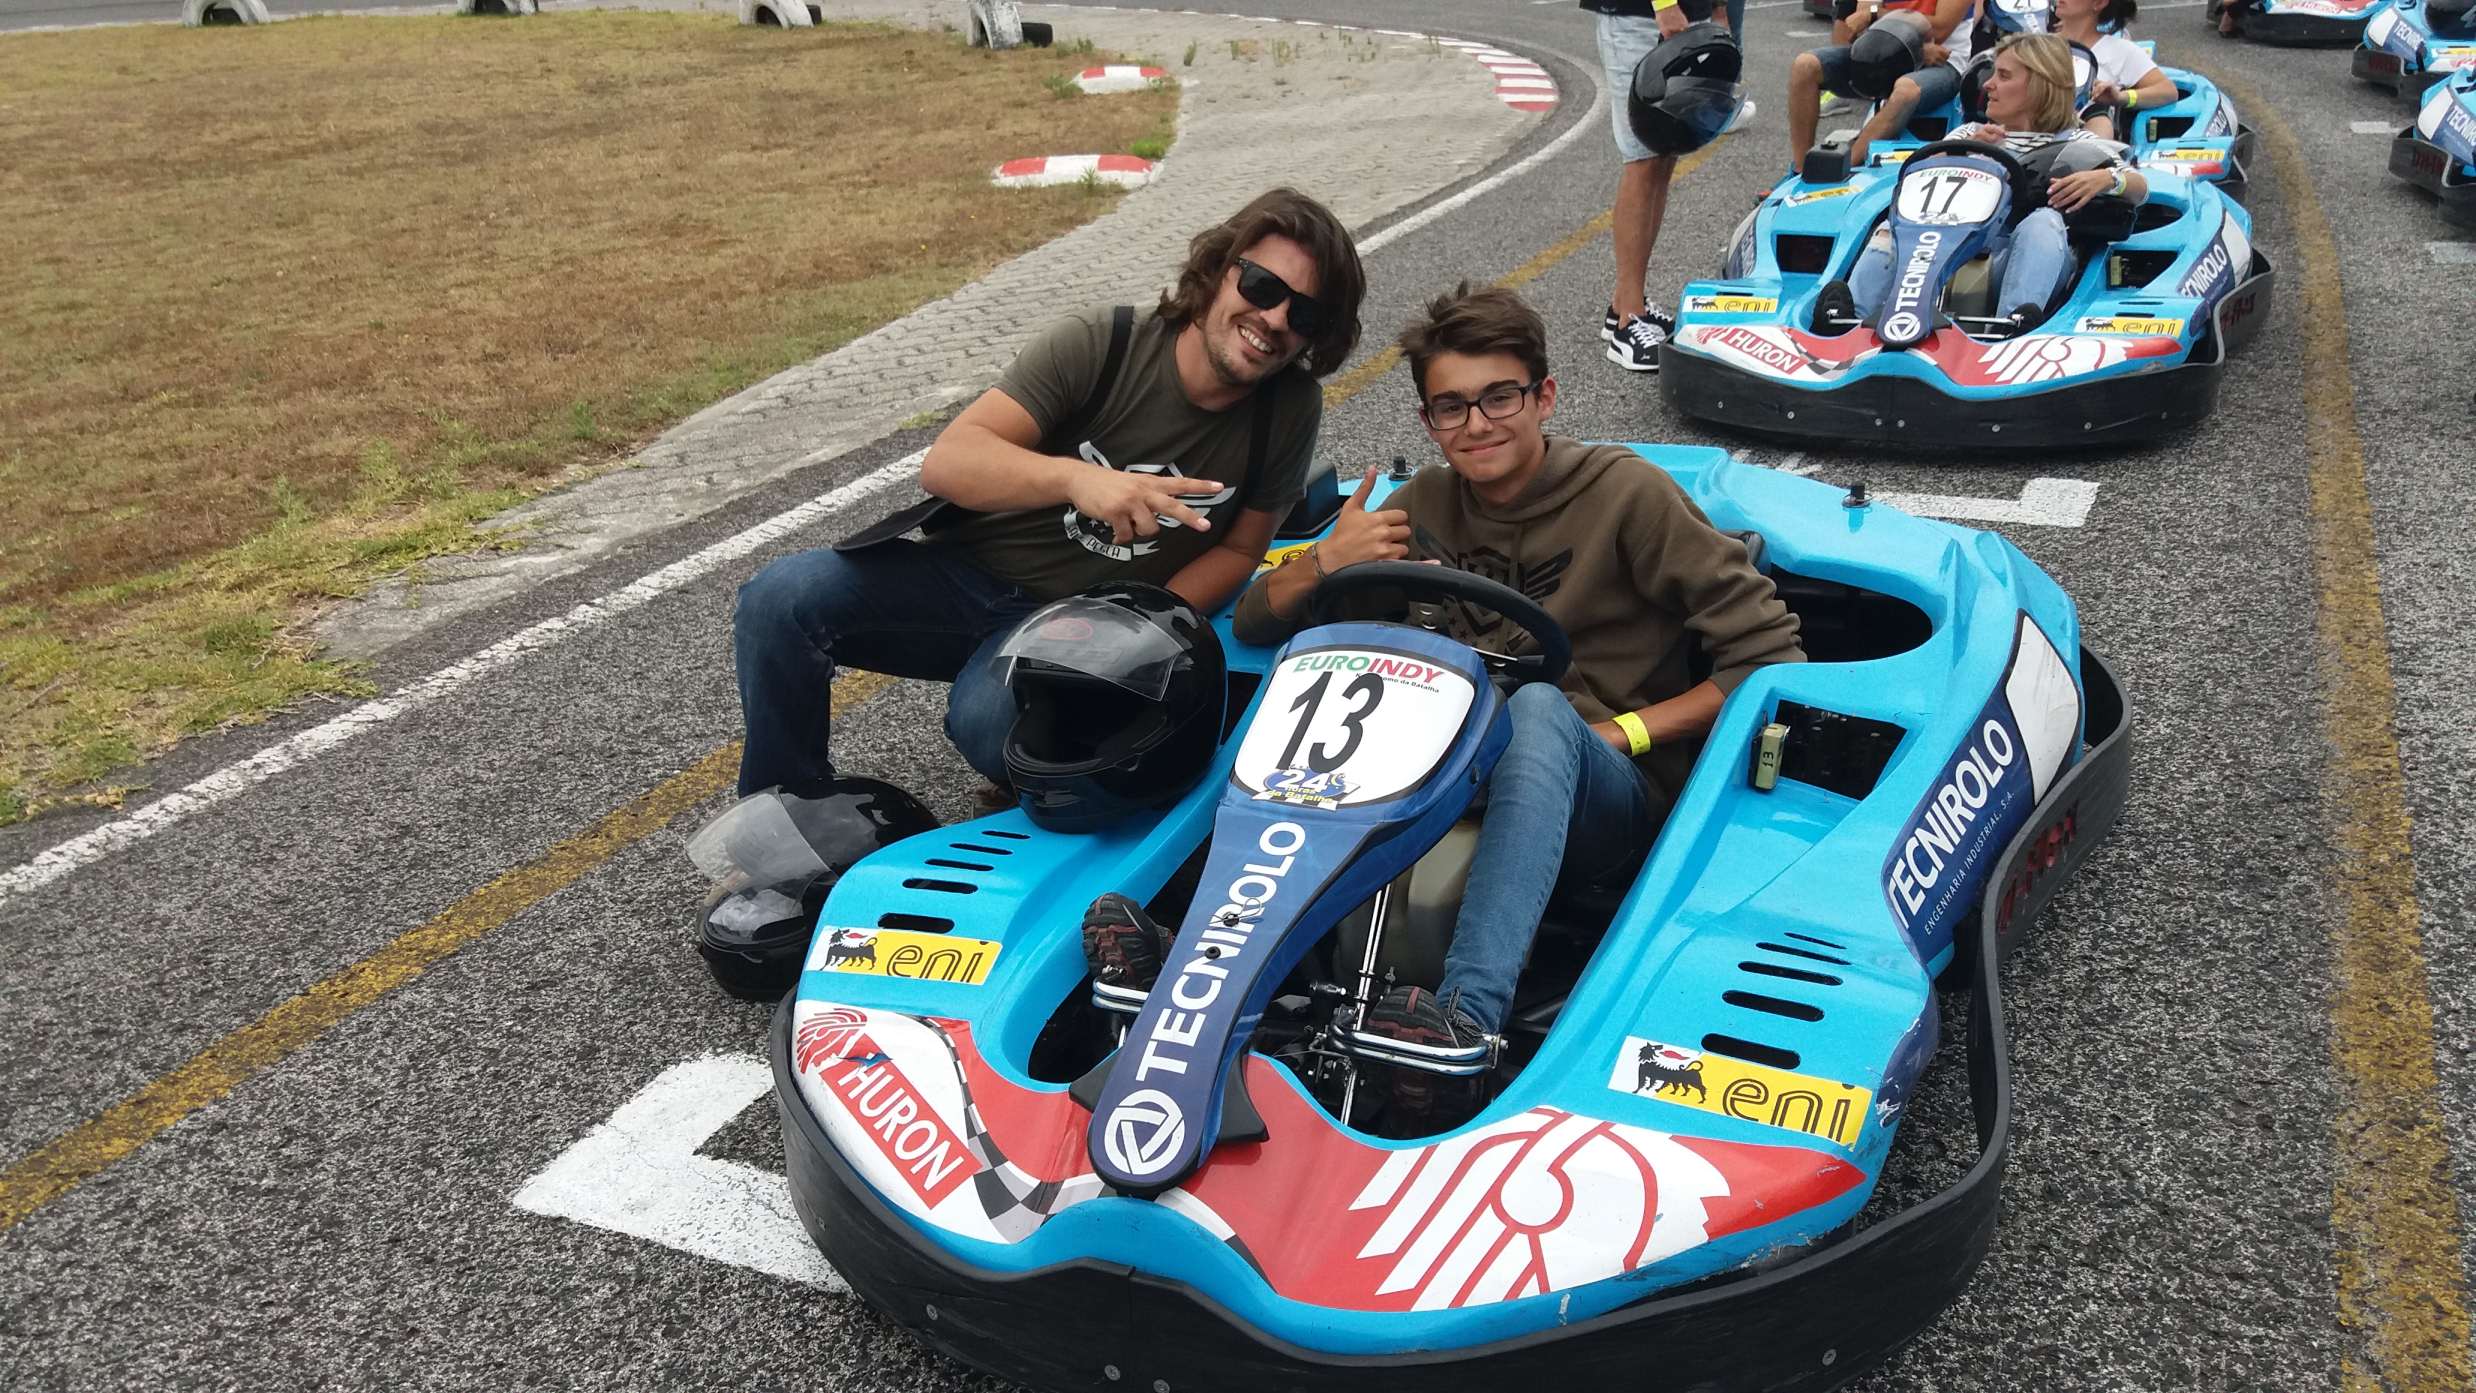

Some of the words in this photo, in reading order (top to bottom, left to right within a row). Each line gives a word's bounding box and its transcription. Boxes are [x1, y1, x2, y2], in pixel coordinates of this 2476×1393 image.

[1920, 168, 1993, 181] EUROINDY
[1920, 176, 1968, 215] 17
[1895, 231, 1941, 311] TECNIROLO
[2122, 318, 2176, 336] eni
[1728, 330, 1799, 370] HURON
[1293, 655, 1444, 683] EUROINDY
[1275, 670, 1385, 773] 13
[1275, 769, 1331, 793] 24
[1762, 751, 1774, 768] 13
[1887, 719, 2014, 930] TECNIROLO
[1924, 868, 1968, 936] ENGENHARIA
[886, 940, 991, 983] eni
[1136, 822, 1306, 1082] TECNIROLO
[838, 1064, 965, 1192] HURON
[1721, 1081, 1857, 1143] eni
